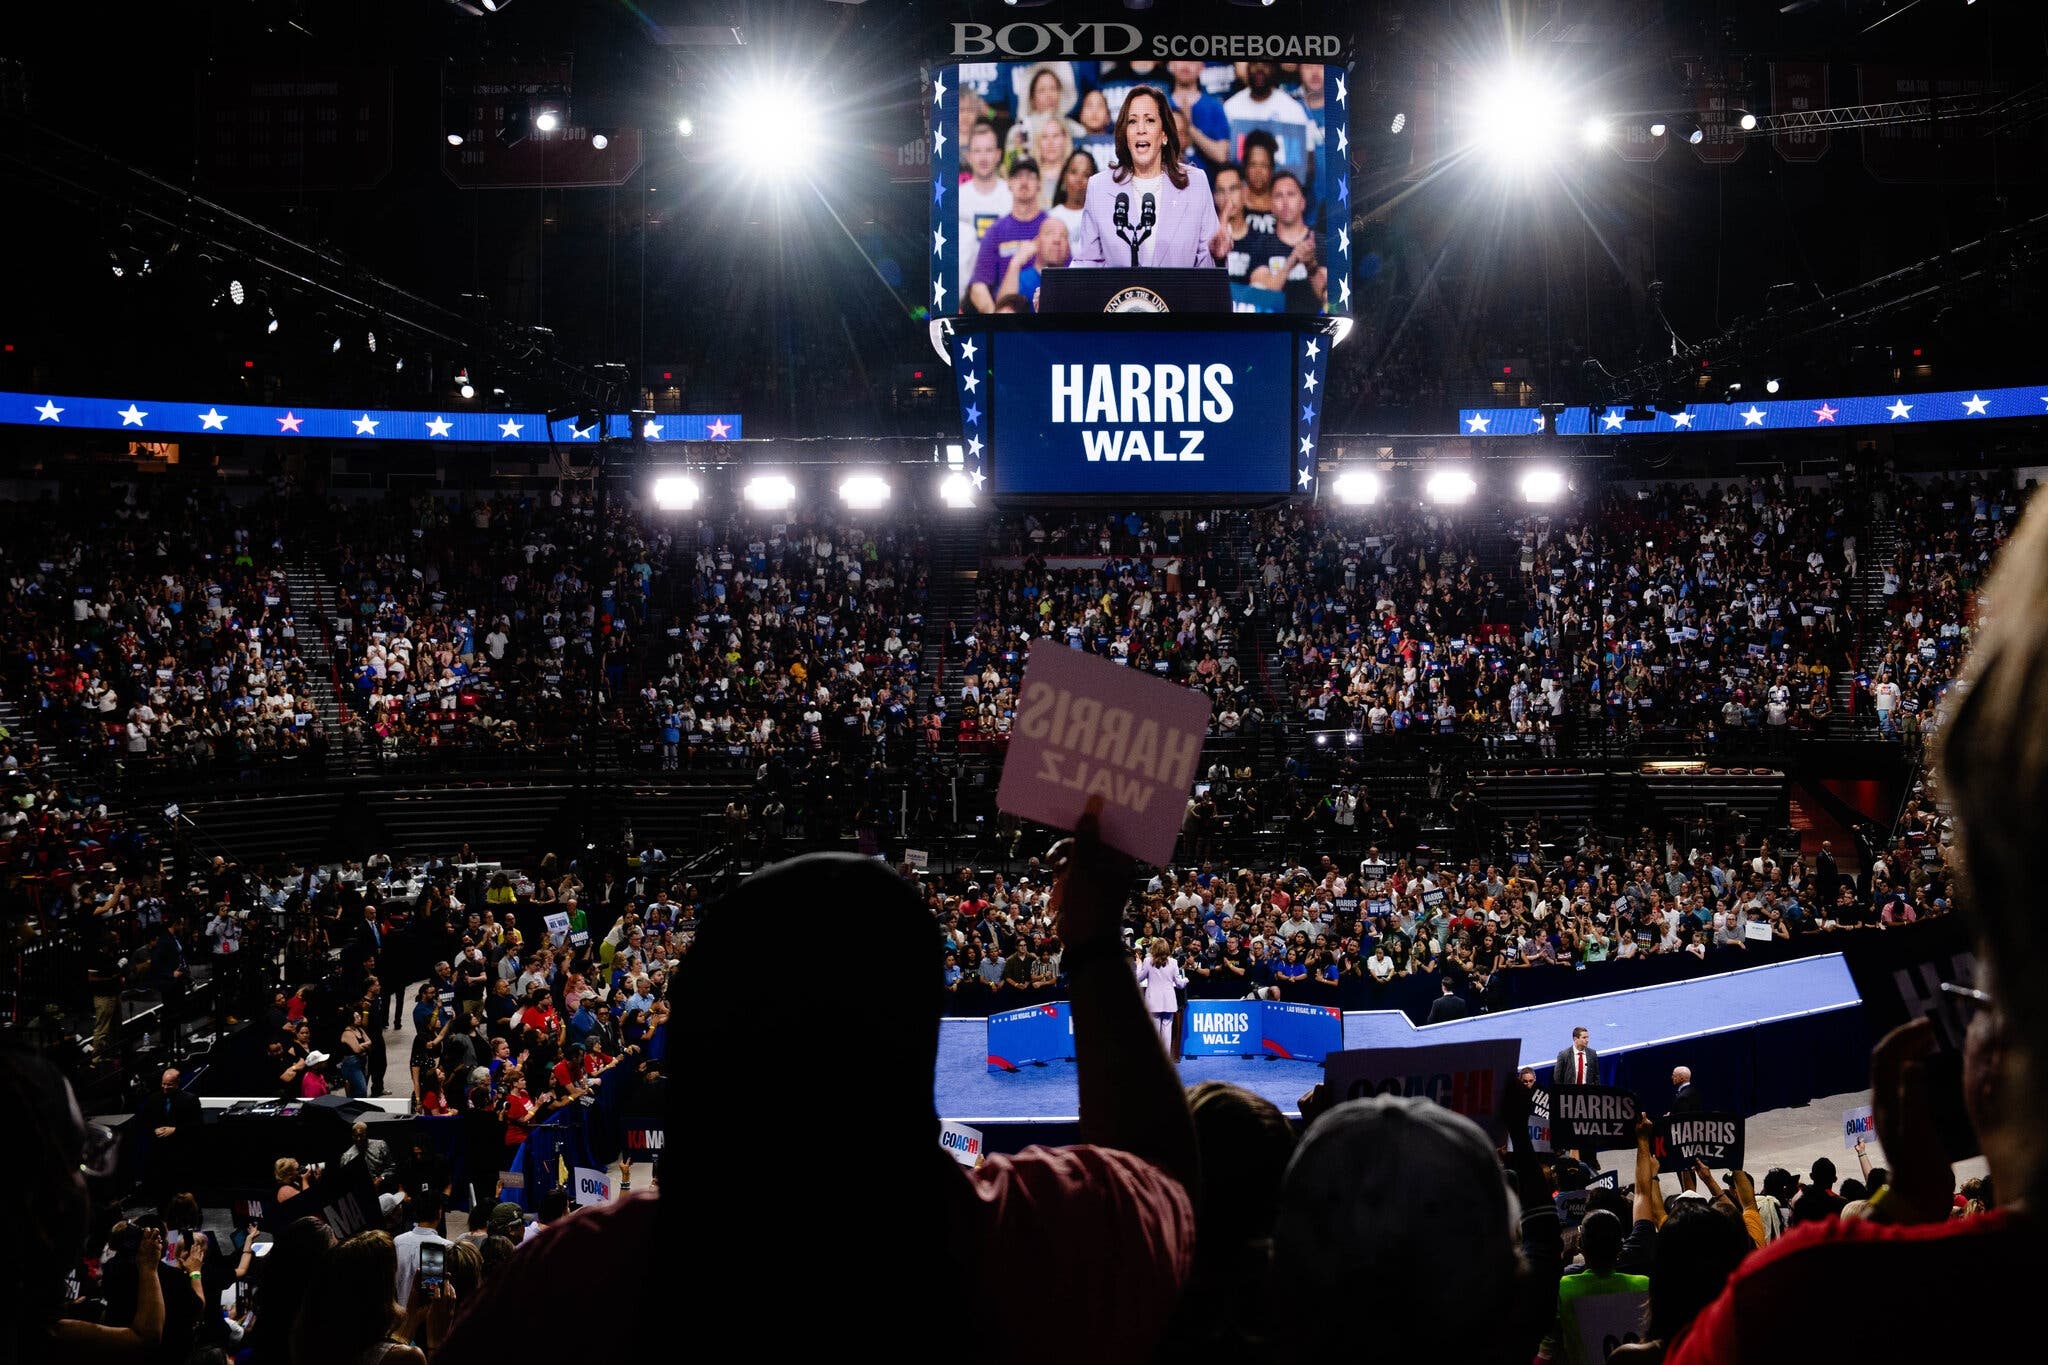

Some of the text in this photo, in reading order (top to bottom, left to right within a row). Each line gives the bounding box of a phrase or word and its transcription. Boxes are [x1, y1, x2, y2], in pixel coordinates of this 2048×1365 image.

[949, 22, 1341, 57] BOYD SCOREBOARD
[897, 138, 931, 166] 198
[1124, 291, 1134, 299] OF
[1136, 290, 1150, 300] THE
[1051, 363, 1234, 423] HARRIS
[1081, 430, 1205, 461] WALZ
[1193, 1012, 1249, 1033] HARRIS
[1202, 1033, 1241, 1045] WALZ
[1559, 1093, 1636, 1121] HARRIS
[1573, 1121, 1625, 1137] WALZ
[1671, 1120, 1736, 1147] HARRIS
[1846, 1115, 1874, 1136] COACH!
[943, 1131, 979, 1154] COACH!
[1681, 1145, 1726, 1159] WALZ
